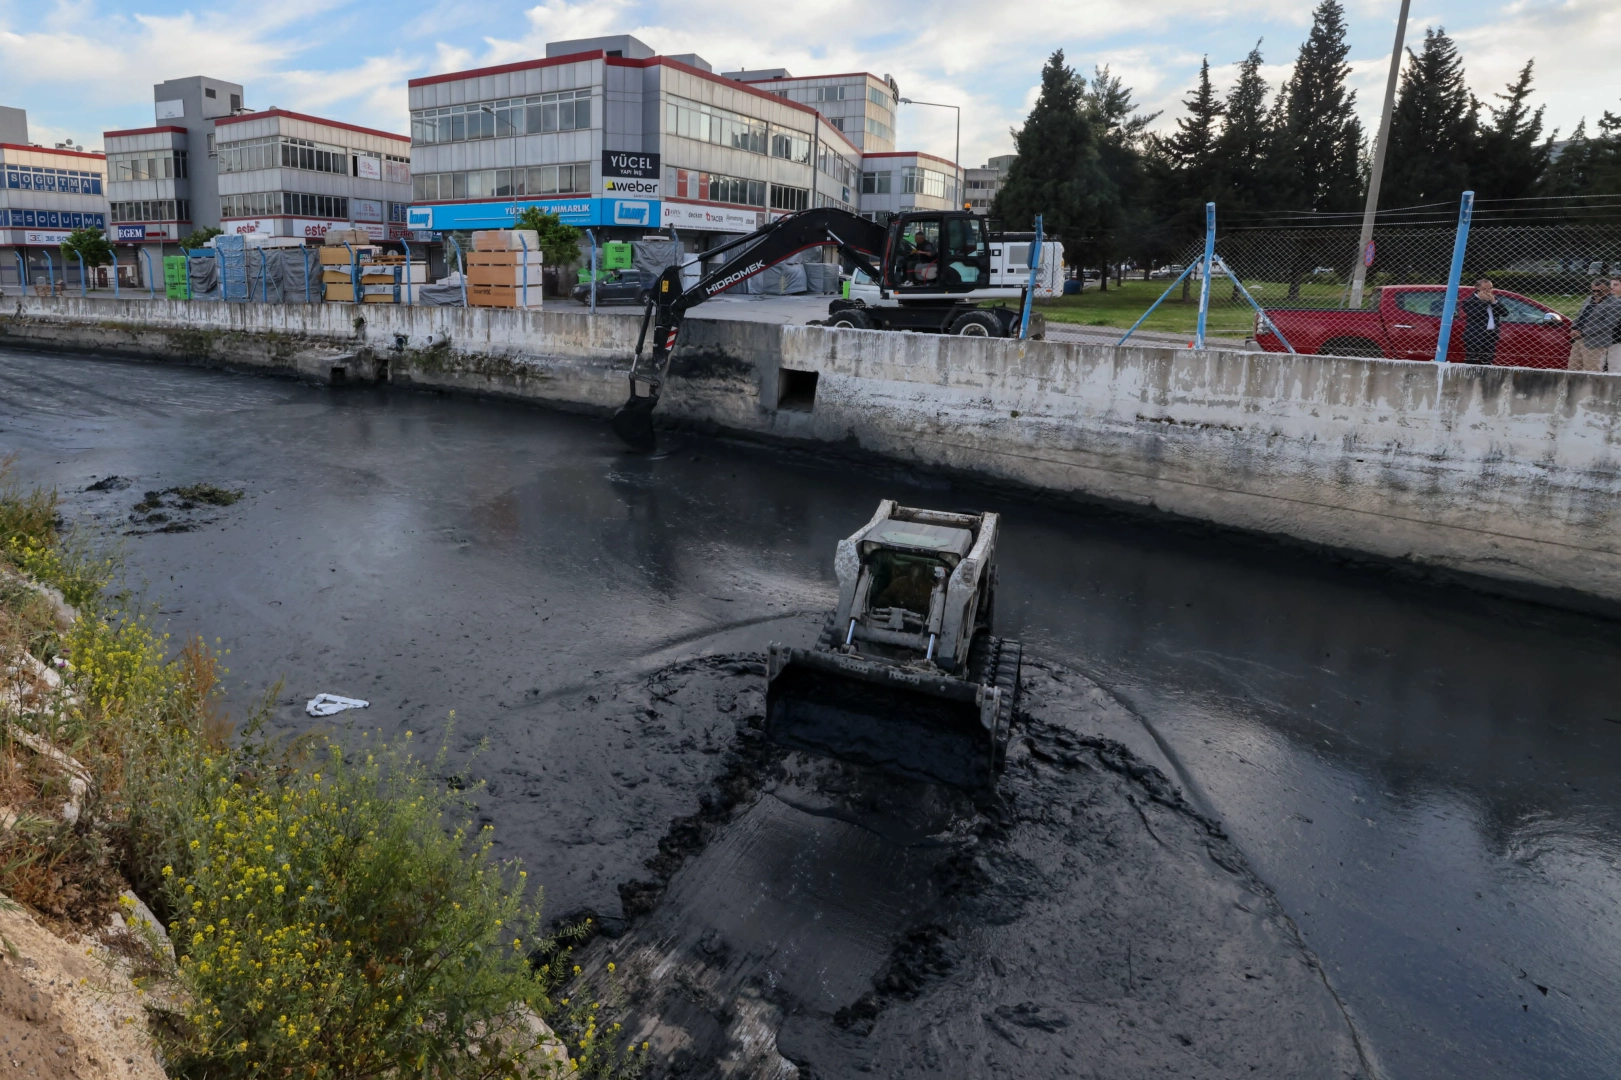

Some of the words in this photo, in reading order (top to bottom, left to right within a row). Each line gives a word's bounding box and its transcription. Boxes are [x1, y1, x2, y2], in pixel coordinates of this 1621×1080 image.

[611, 151, 652, 169] YÜCEL
[11, 173, 89, 188] SOĞUTMA
[616, 180, 658, 193] weber
[551, 203, 590, 213] MİMARLIK
[618, 202, 647, 224] knauf
[26, 215, 102, 225] SOĞUTMA
[409, 209, 430, 227] knauf
[118, 229, 143, 238] EGEM
[304, 223, 327, 236] este
